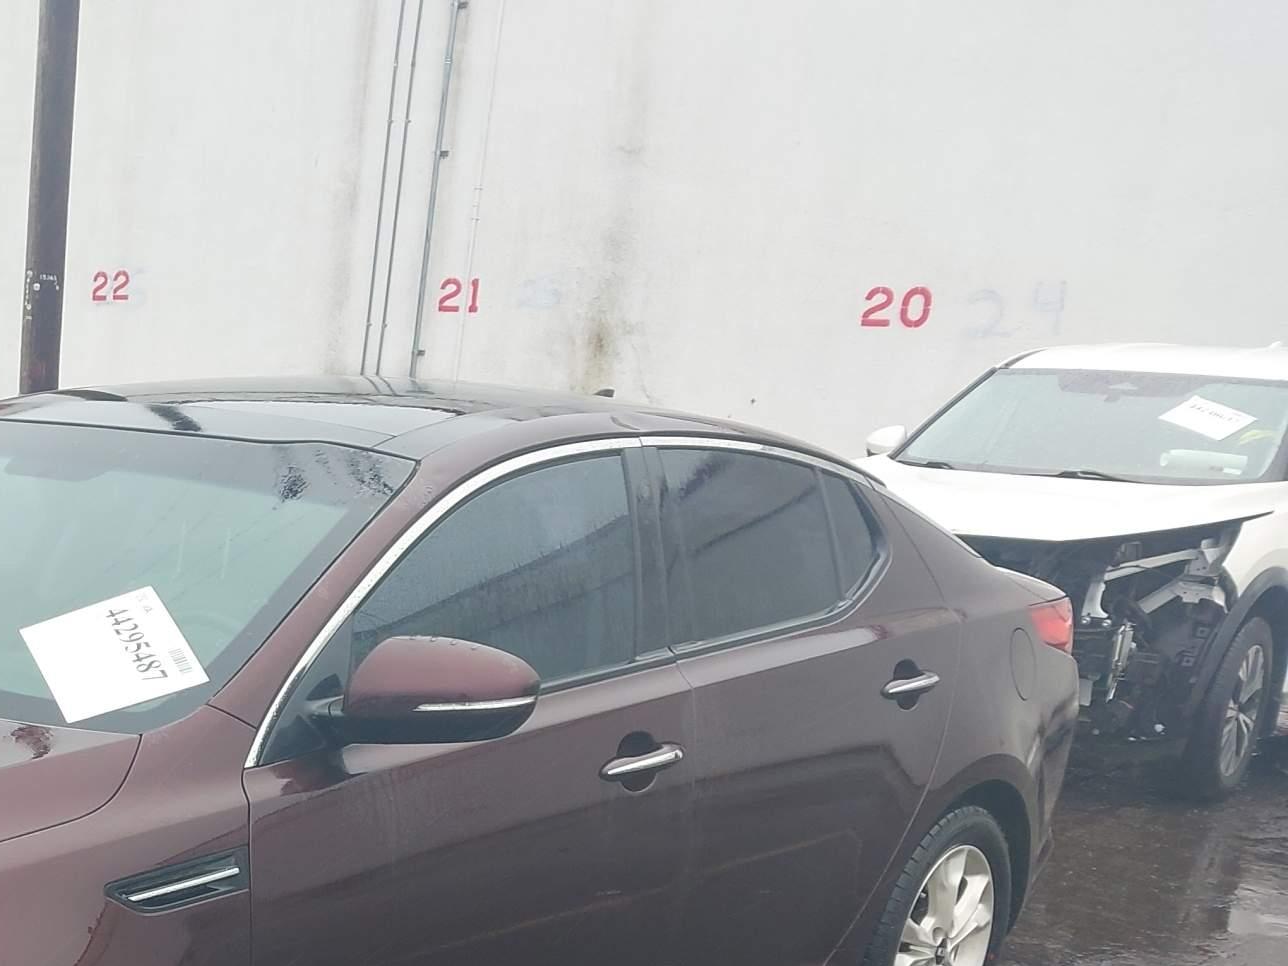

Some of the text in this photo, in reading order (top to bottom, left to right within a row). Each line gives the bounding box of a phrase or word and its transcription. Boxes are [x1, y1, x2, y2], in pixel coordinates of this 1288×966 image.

[91, 270, 130, 301] 22
[438, 277, 480, 313] 21
[860, 285, 934, 329] 20
[105, 608, 169, 681] 44295487
